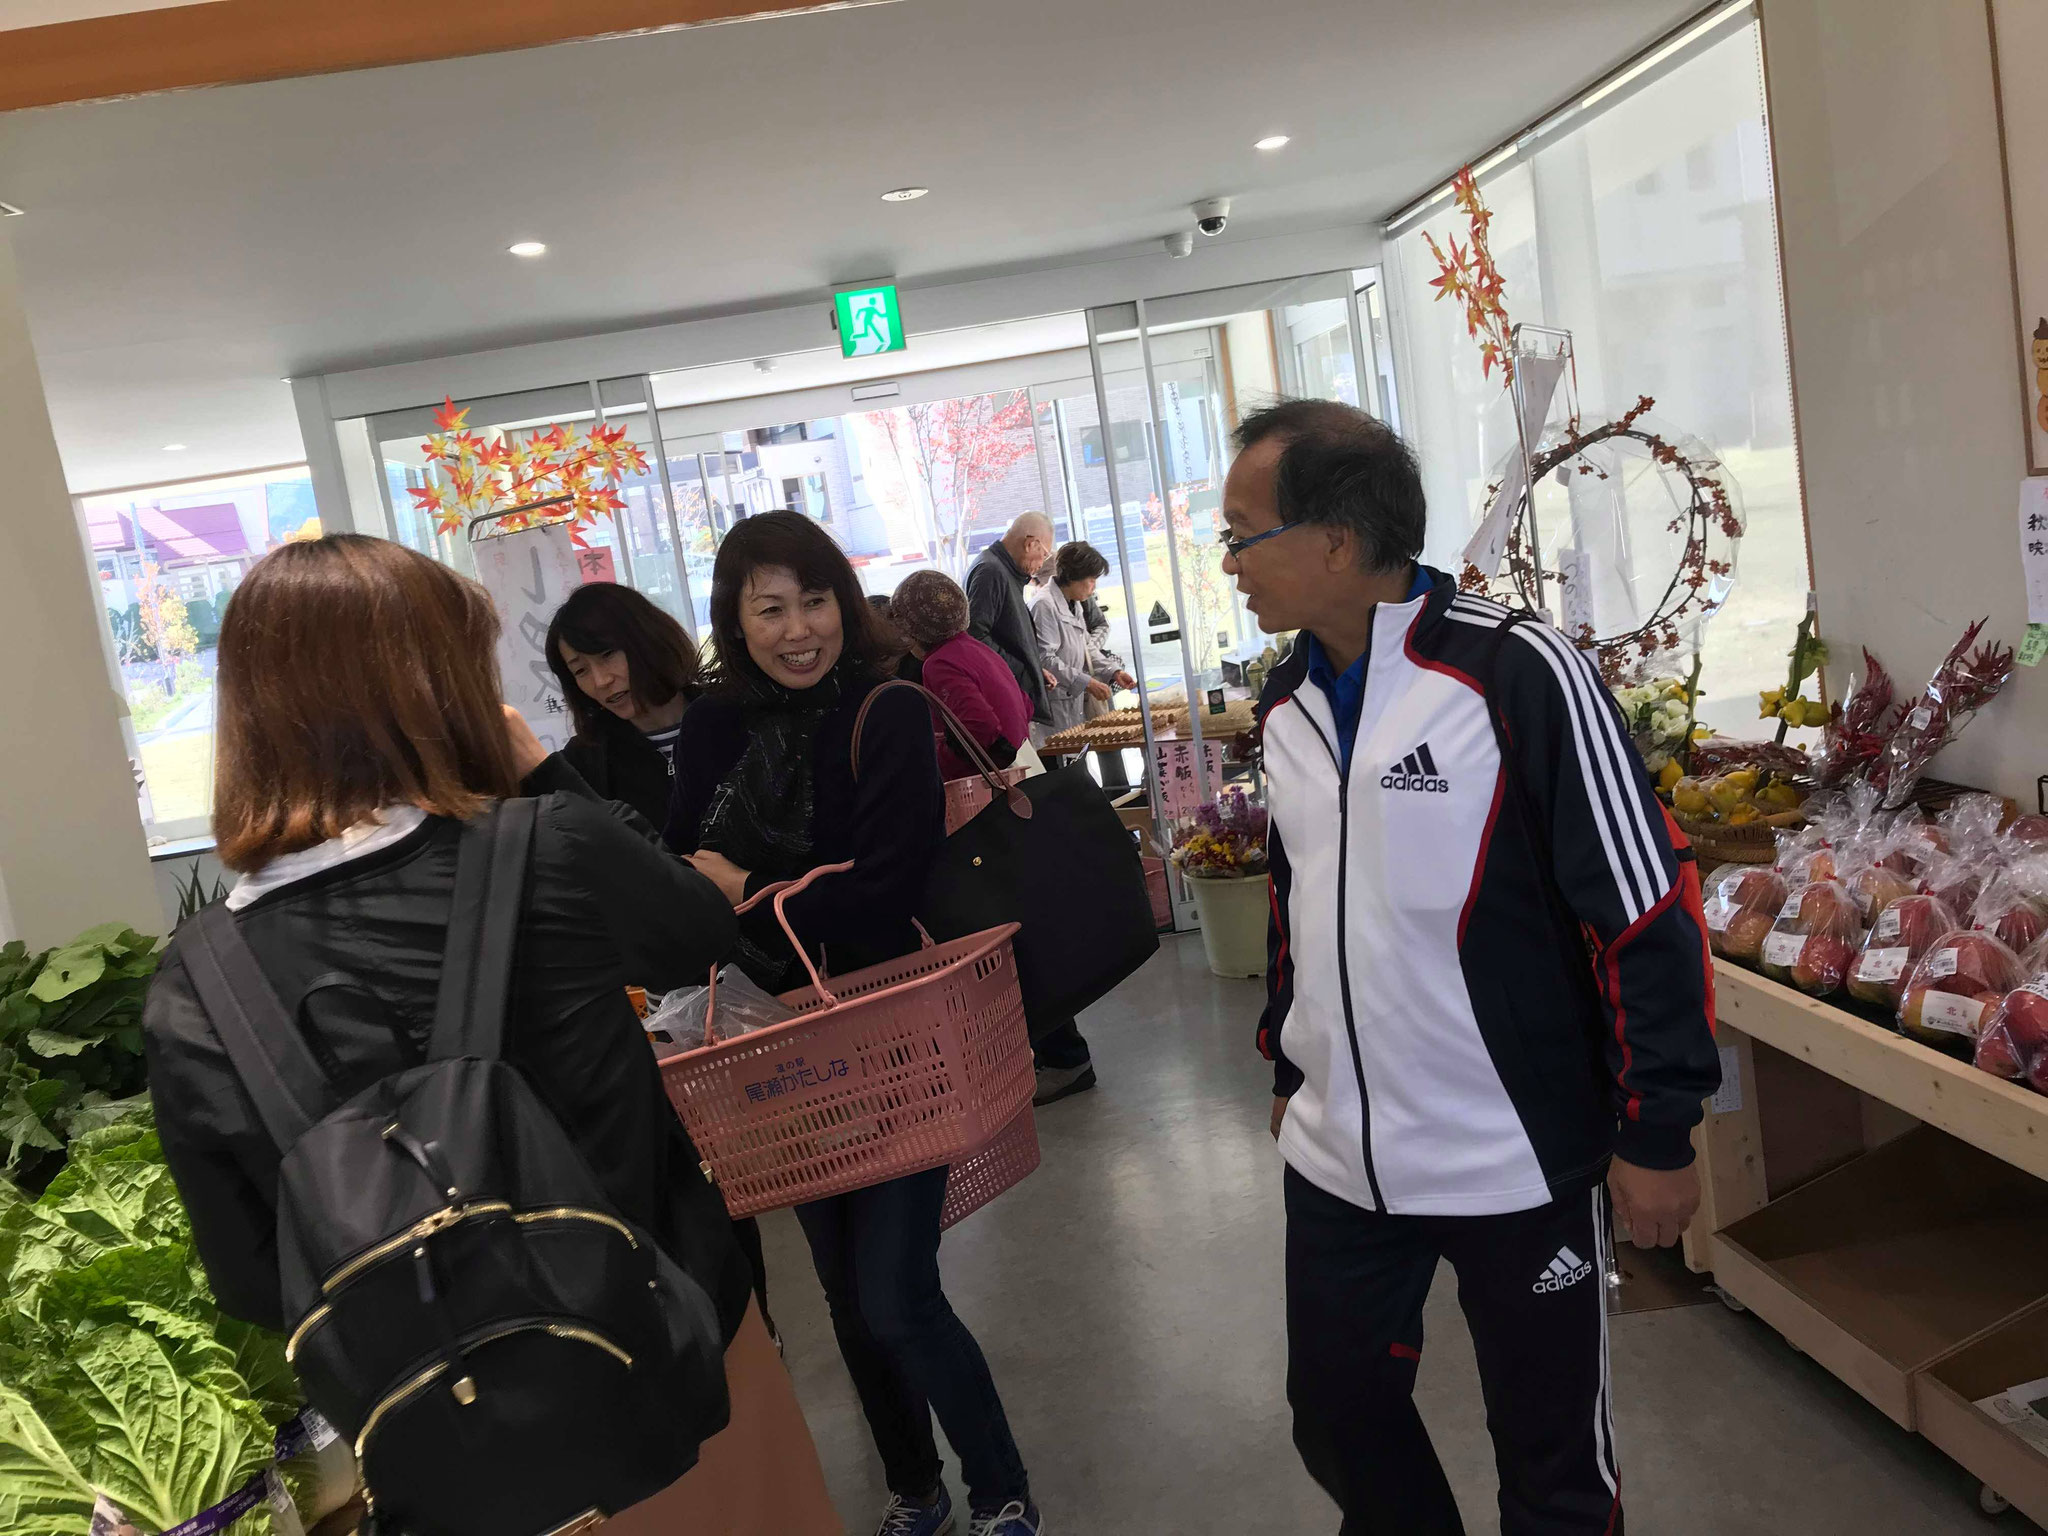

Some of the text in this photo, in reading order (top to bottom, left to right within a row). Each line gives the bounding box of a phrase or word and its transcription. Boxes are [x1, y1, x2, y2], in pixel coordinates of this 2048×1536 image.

[1380, 773, 1449, 793] adidas
[775, 1057, 806, 1073] 道の駅
[744, 1059, 849, 1104] 尾瀬かたしな
[1532, 1261, 1593, 1293] adidas
